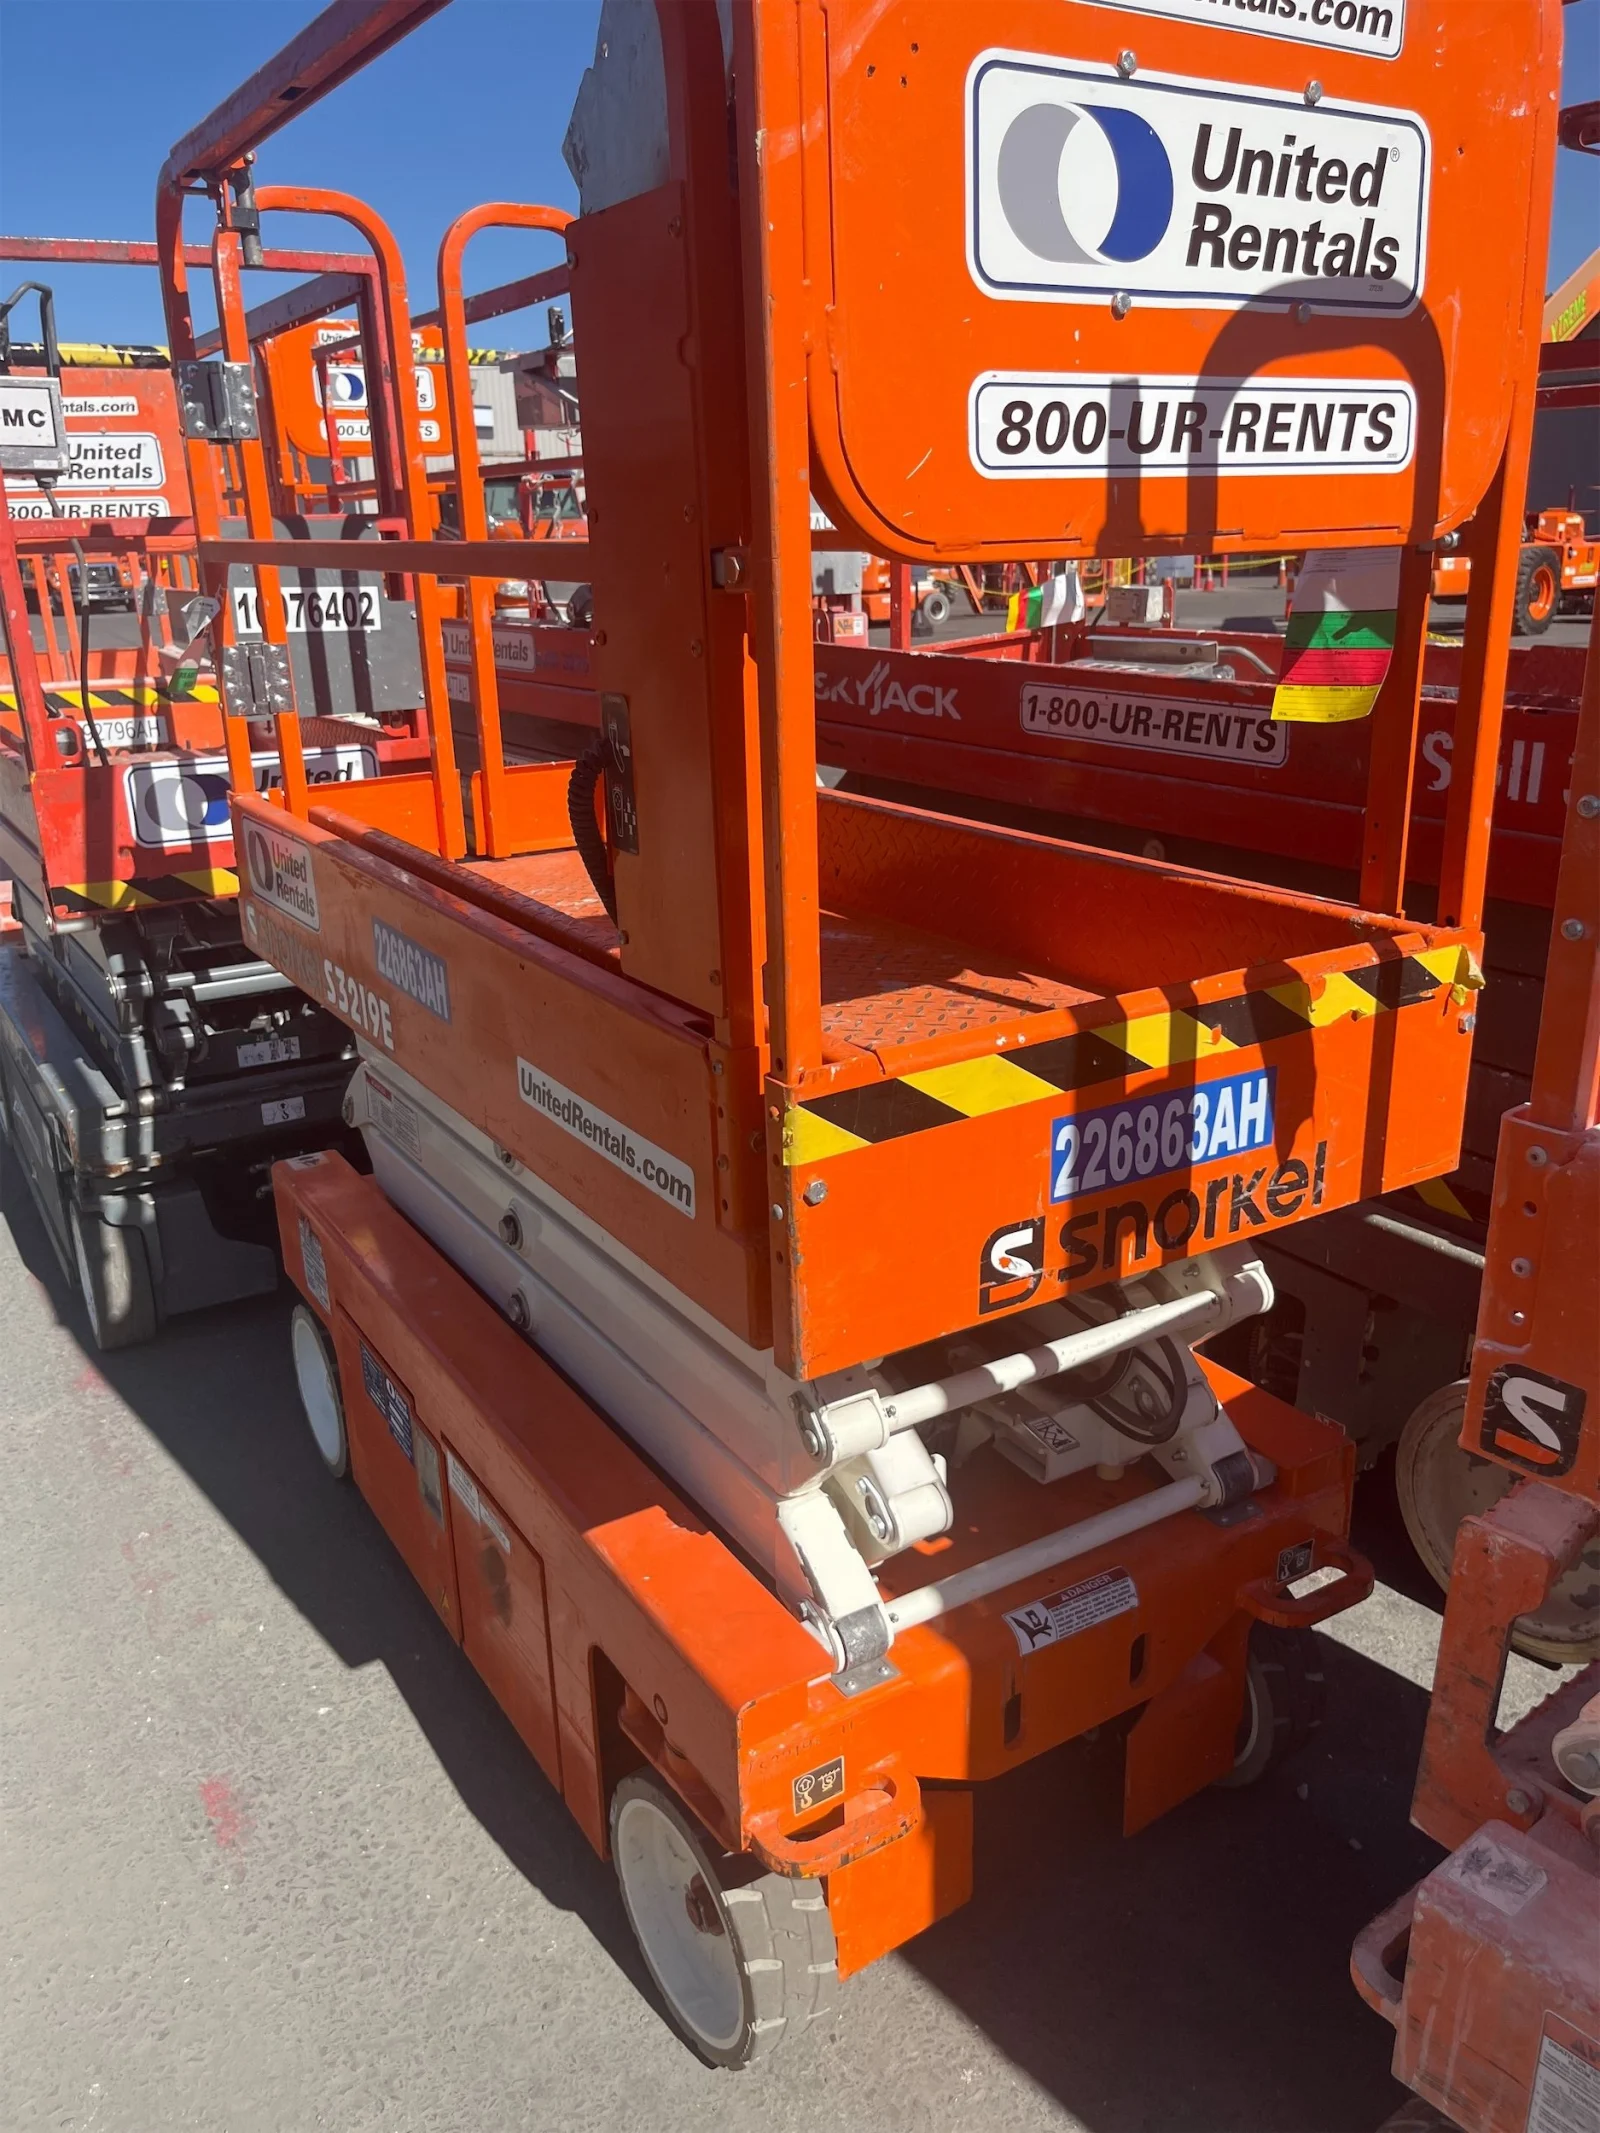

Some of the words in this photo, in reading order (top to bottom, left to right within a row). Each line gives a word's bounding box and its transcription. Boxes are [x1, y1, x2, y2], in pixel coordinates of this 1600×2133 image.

[1191, 123, 1389, 208] United
[1185, 202, 1400, 281] Rentals
[61, 401, 136, 414] ntals.com
[996, 400, 1396, 455] 800-UR-RENTS
[67, 443, 142, 460] United
[67, 463, 154, 480] Rentals
[238, 592, 375, 629] 176402
[494, 640, 529, 662] entals
[814, 659, 962, 721] SKYJACK
[1026, 693, 1278, 754] 1-800-UR-RENTS
[271, 841, 308, 885] United
[275, 872, 316, 918] Rentals
[374, 922, 450, 1020] 226863AH
[323, 958, 395, 1051] S3219E
[520, 1067, 692, 1208] UnitedRentals.com
[1053, 1077, 1269, 1199] 226863AH
[1057, 1139, 1328, 1283] snorkel
[1068, 1574, 1112, 1598] DANGER
